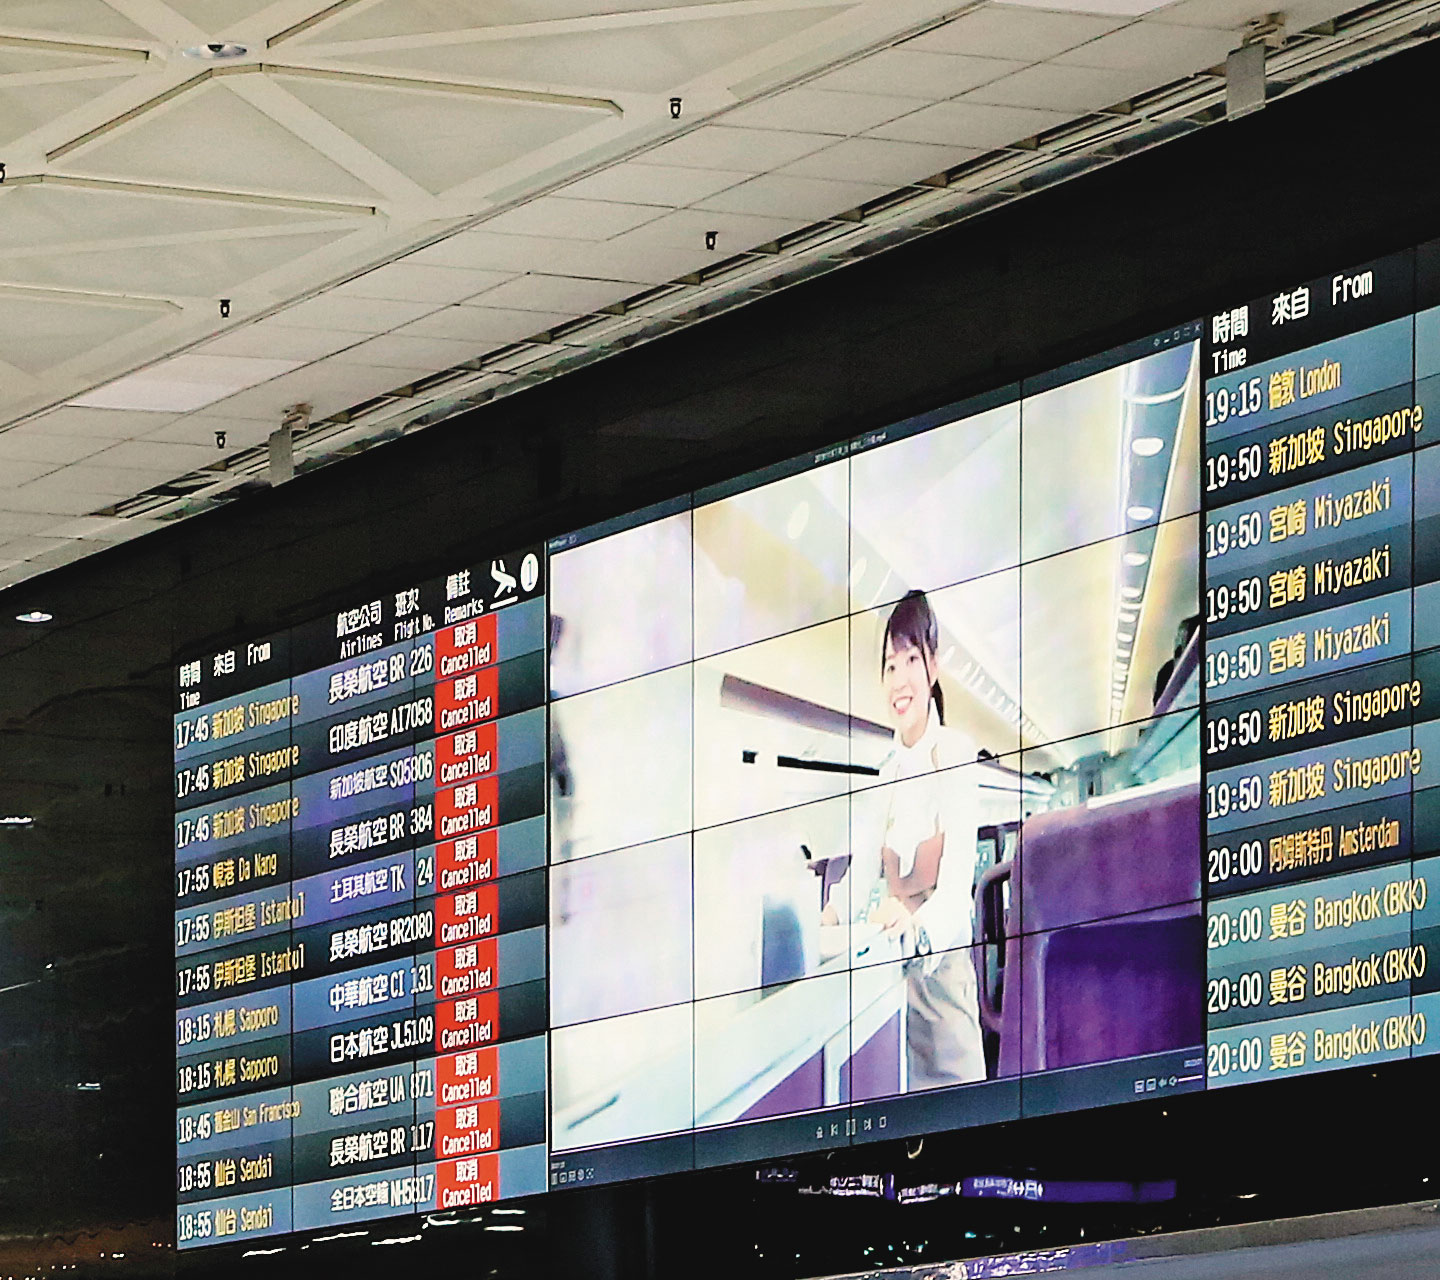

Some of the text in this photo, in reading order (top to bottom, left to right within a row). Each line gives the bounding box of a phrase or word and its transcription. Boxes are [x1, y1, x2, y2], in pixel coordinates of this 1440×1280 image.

[1212, 271, 1372, 343] 時間 來自 From
[1212, 347, 1246, 374] Time
[1206, 377, 1261, 427] 19:15
[1269, 368, 1296, 410] 倫敦
[1300, 359, 1341, 399] London
[1206, 444, 1261, 492] 19:50
[1269, 426, 1325, 476] 新加坡
[1334, 405, 1423, 454] Singapore
[1206, 511, 1261, 558] 19:50
[1269, 499, 1307, 542] 宮崎
[1314, 477, 1390, 529] Miyazaki
[454, 622, 477, 648] 取消
[440, 643, 491, 677] Cancelled
[176, 644, 432, 750] 17:45 新加坡 Singapore 長榮航空 BR 226
[441, 804, 491, 836] Cancelled
[454, 783, 477, 809] 取消
[177, 864, 209, 897] 17:55
[238, 857, 251, 878] Da
[254, 853, 277, 878] Nang
[329, 818, 388, 859] 長榮航空
[390, 812, 405, 841] BR
[410, 805, 433, 836] 384
[1208, 908, 1262, 949] 20:00
[1269, 900, 1307, 940] 曼谷
[1208, 1037, 1262, 1077] 20:00
[1269, 1031, 1307, 1070] 曼谷
